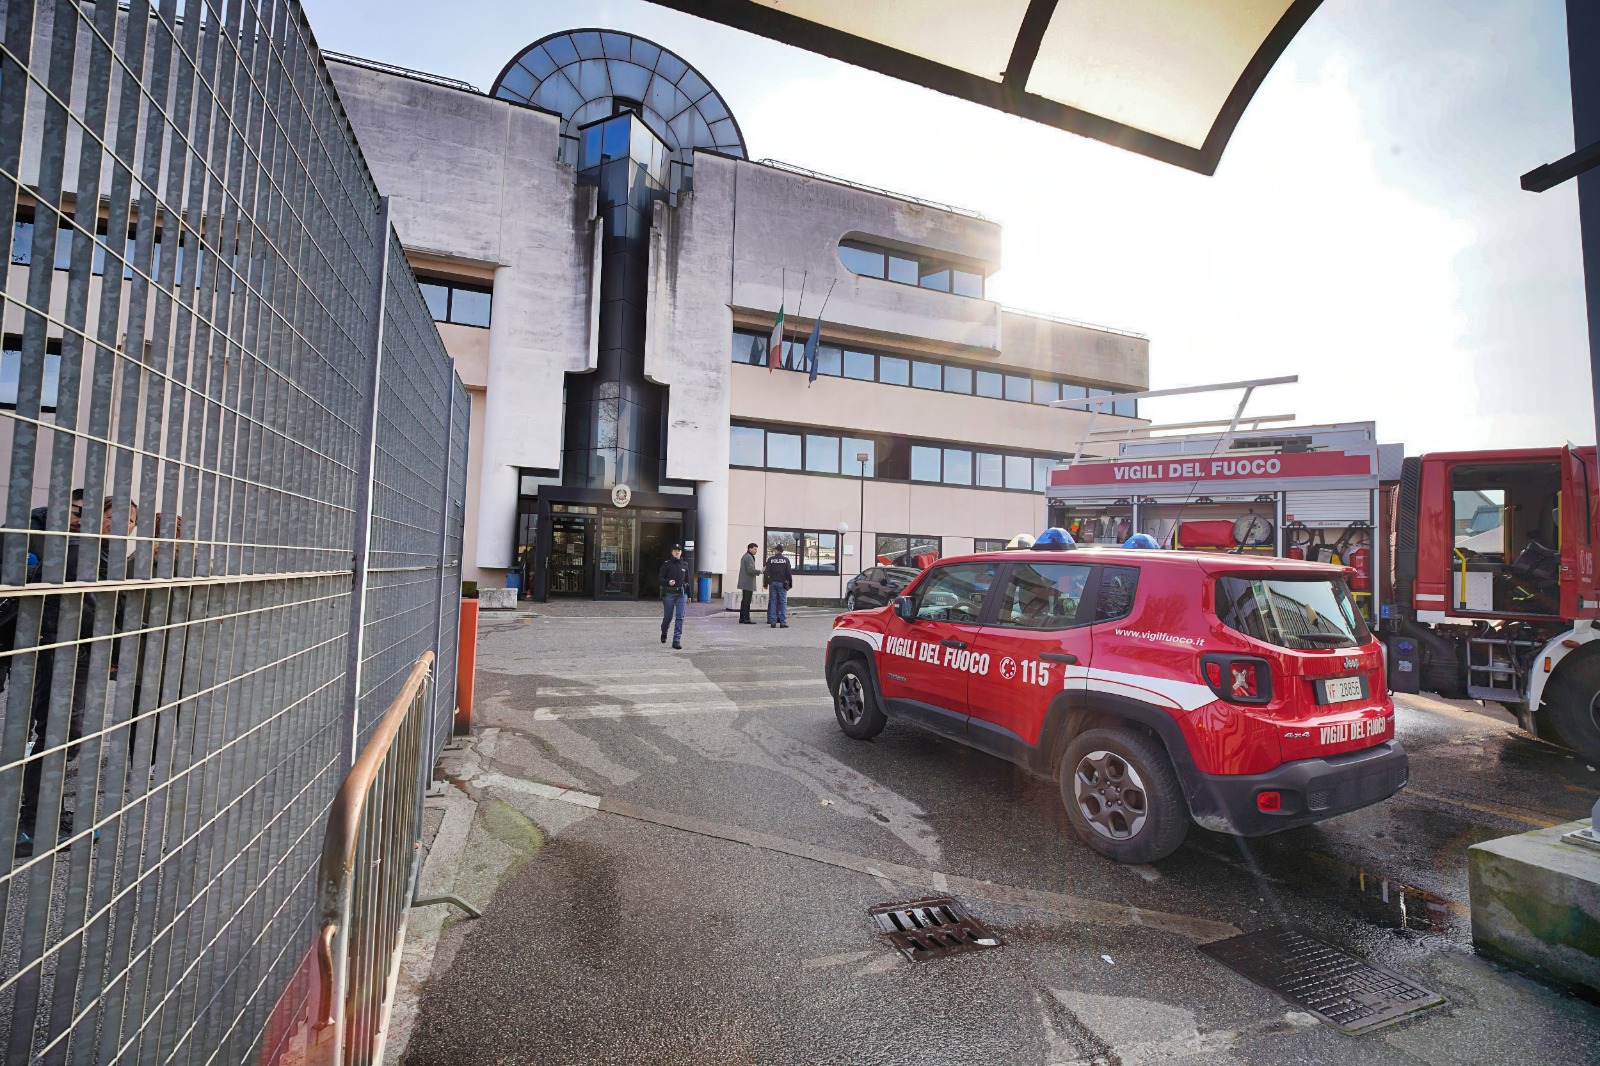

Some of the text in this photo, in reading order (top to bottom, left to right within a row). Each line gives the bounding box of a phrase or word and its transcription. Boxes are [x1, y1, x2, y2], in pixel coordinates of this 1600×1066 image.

[1113, 458, 1281, 480] VIGILI DEL FUOCO
[1115, 628, 1205, 646] www.vigilfuoco.it
[886, 635, 1050, 687] VIGILI DEL FUOCO 115
[1343, 657, 1360, 670] Jeep
[1327, 681, 1361, 699] VF 28856
[1320, 716, 1386, 745] VIGILI DEL FUOCO
